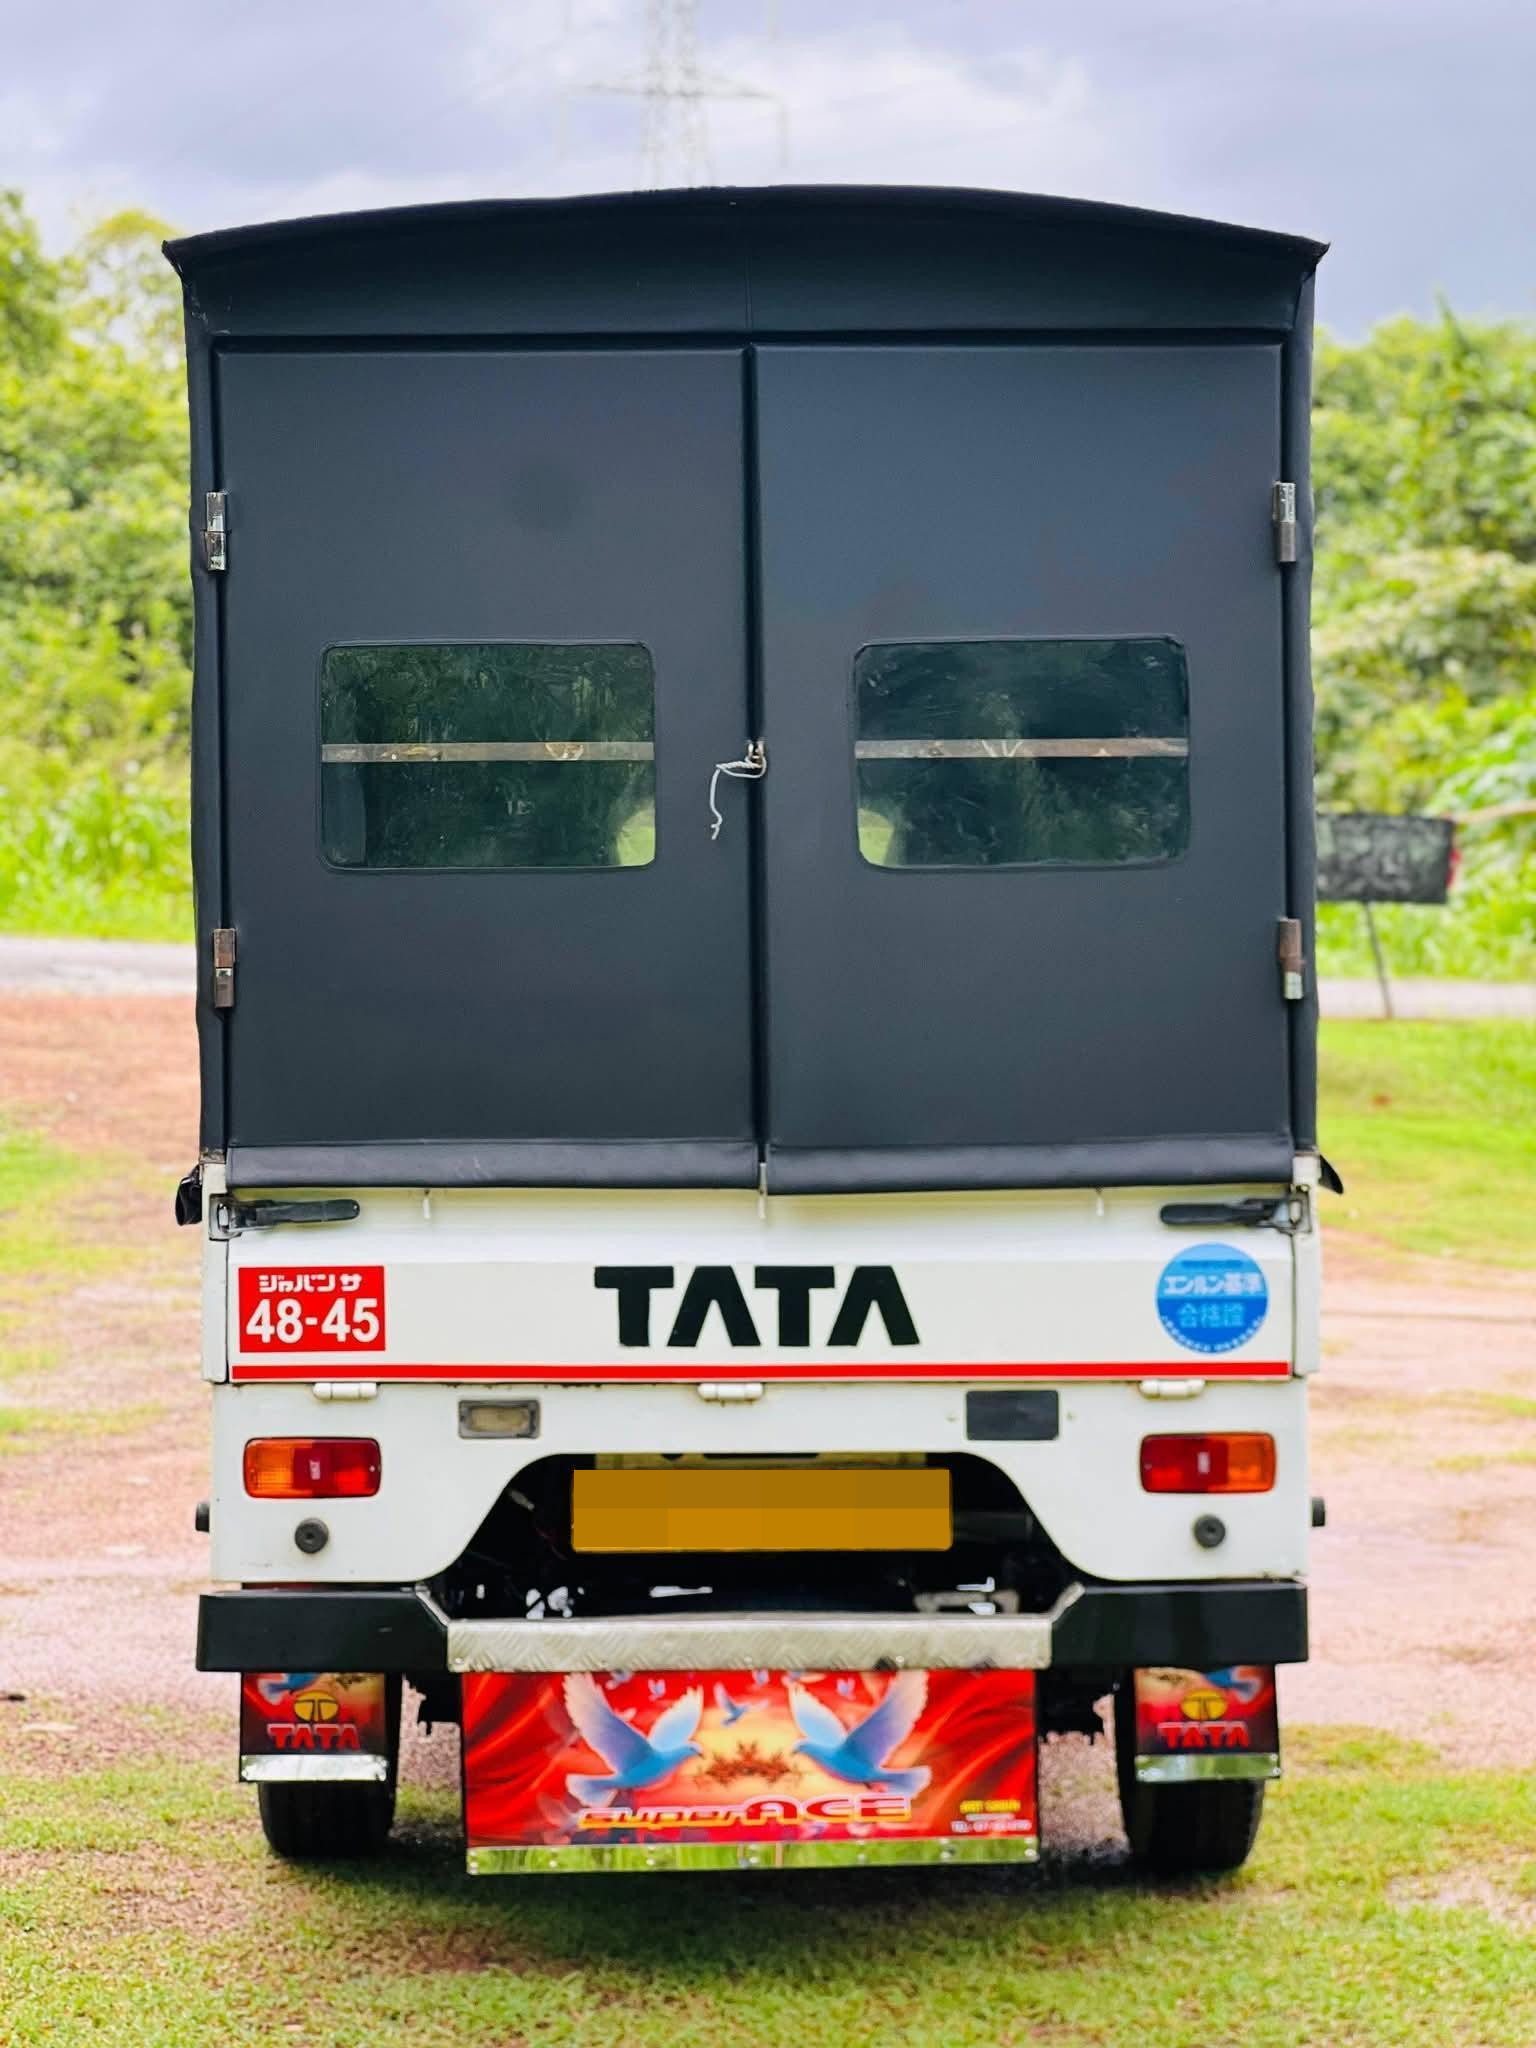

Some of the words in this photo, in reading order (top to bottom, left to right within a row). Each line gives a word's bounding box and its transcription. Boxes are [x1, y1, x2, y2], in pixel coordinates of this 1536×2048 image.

[246, 1297, 380, 1344] 48-45
[594, 1266, 920, 1347] TATA
[267, 1723, 360, 1750] TATA
[1157, 1721, 1250, 1749] TATA
